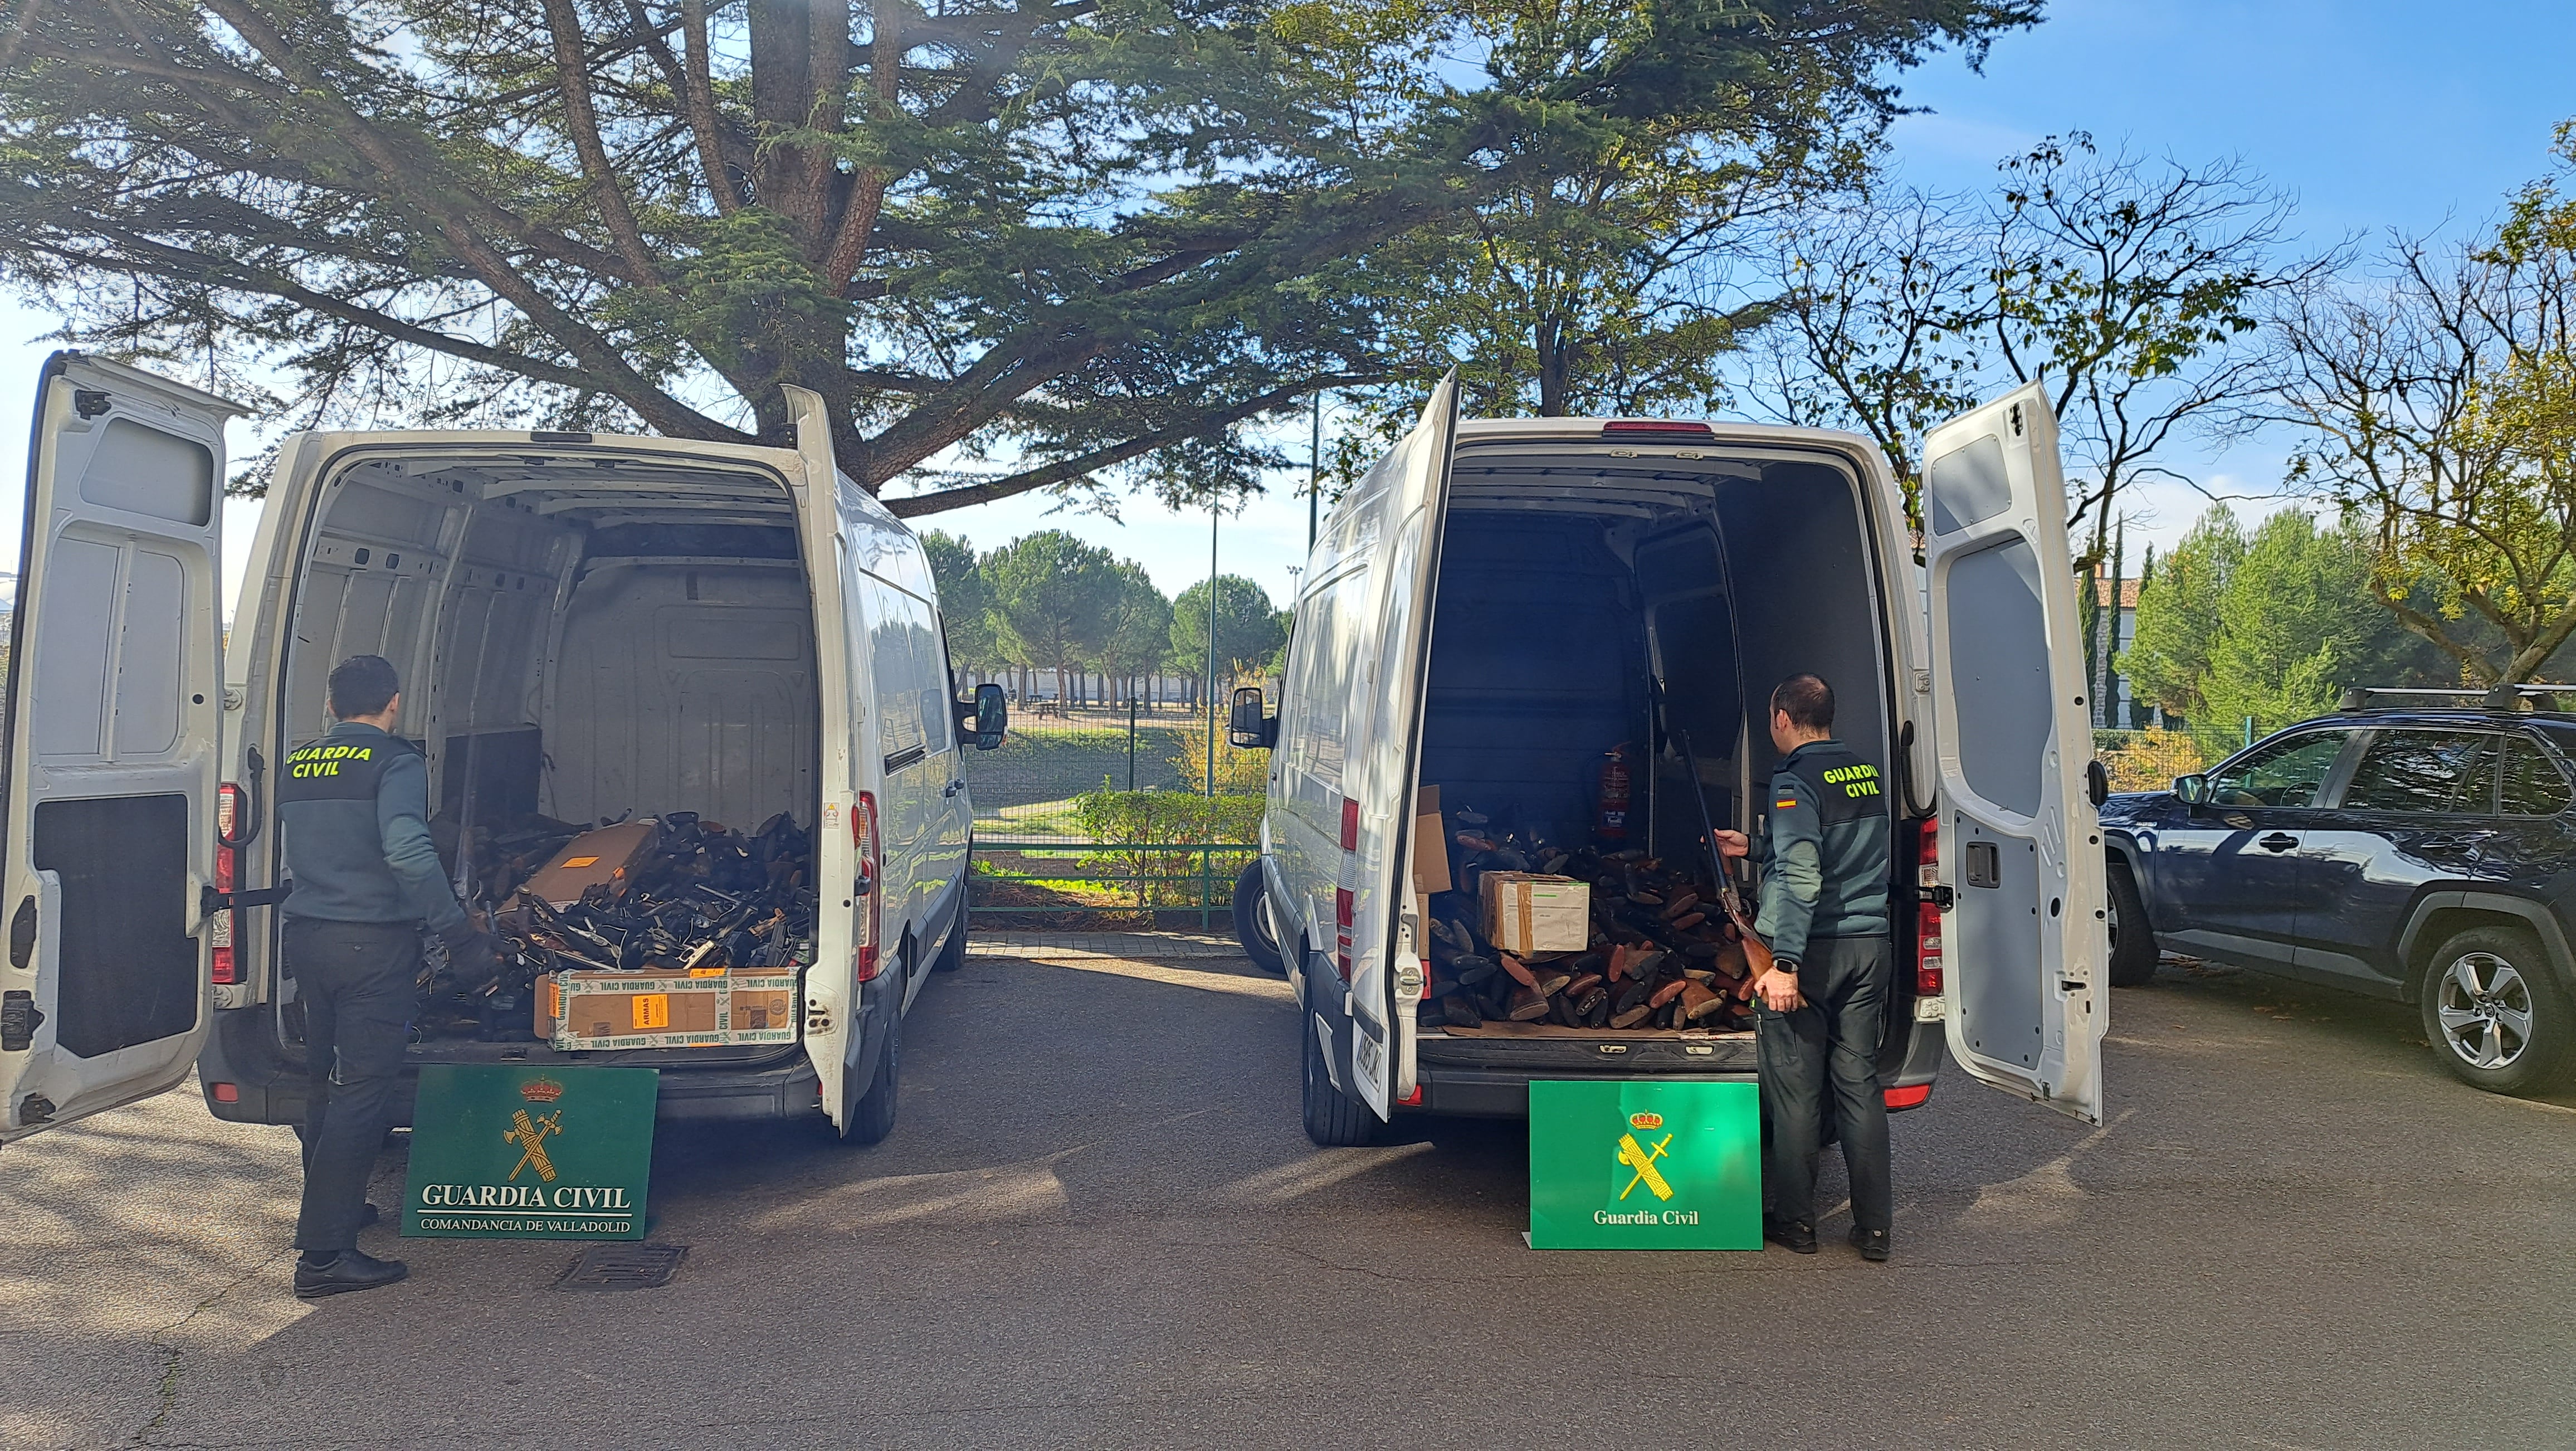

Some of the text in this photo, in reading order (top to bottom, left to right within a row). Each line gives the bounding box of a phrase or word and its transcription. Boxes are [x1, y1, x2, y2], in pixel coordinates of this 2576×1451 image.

[286, 746, 372, 765] GUARDIA
[292, 761, 340, 778] CIVIL
[1846, 780, 1880, 798] CIVIL
[599, 982, 619, 991] CIVIL
[622, 981, 655, 990] GUARDIA
[674, 981, 692, 989] CIVIL
[695, 980, 728, 989] GUARDIA
[747, 979, 764, 987] CIVIL
[719, 1011, 728, 1030] CIVIL
[665, 1035, 684, 1045] CIVIL
[686, 1034, 719, 1044] GUARDIA
[737, 1032, 756, 1041] CIVIL
[758, 1031, 791, 1041] GUARDIA
[591, 1040, 610, 1048] CIVIL
[613, 1037, 646, 1046] GUARDIA
[1369, 1048, 1382, 1084] JKL
[421, 1185, 631, 1209] GUARDIA CIVIL
[1593, 1210, 1699, 1226] Guardia Civil
[421, 1218, 631, 1233] COMANDANCIA DE VALLADOLID
